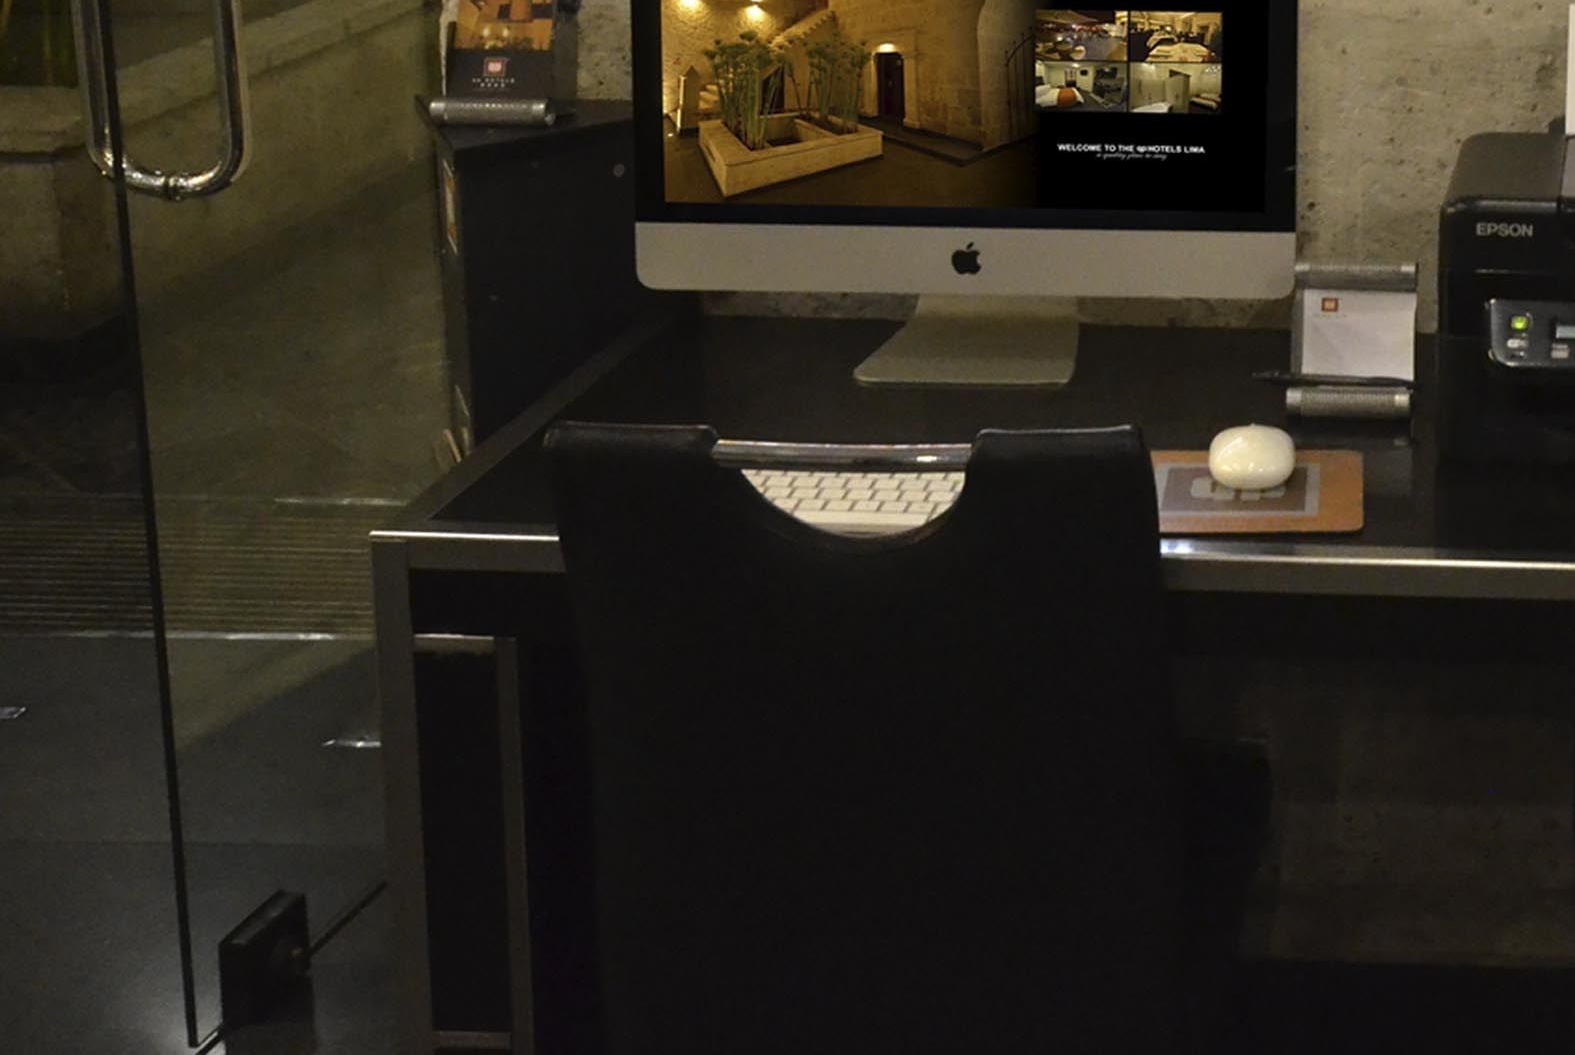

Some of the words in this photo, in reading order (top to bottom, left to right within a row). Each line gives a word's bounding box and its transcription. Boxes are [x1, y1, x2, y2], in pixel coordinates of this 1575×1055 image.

[1057, 143, 1102, 152] WELCOME
[1104, 144, 1116, 152] TO
[1118, 144, 1134, 152] THE
[1184, 145, 1206, 154] LIMA
[1475, 222, 1534, 238] EPSON
